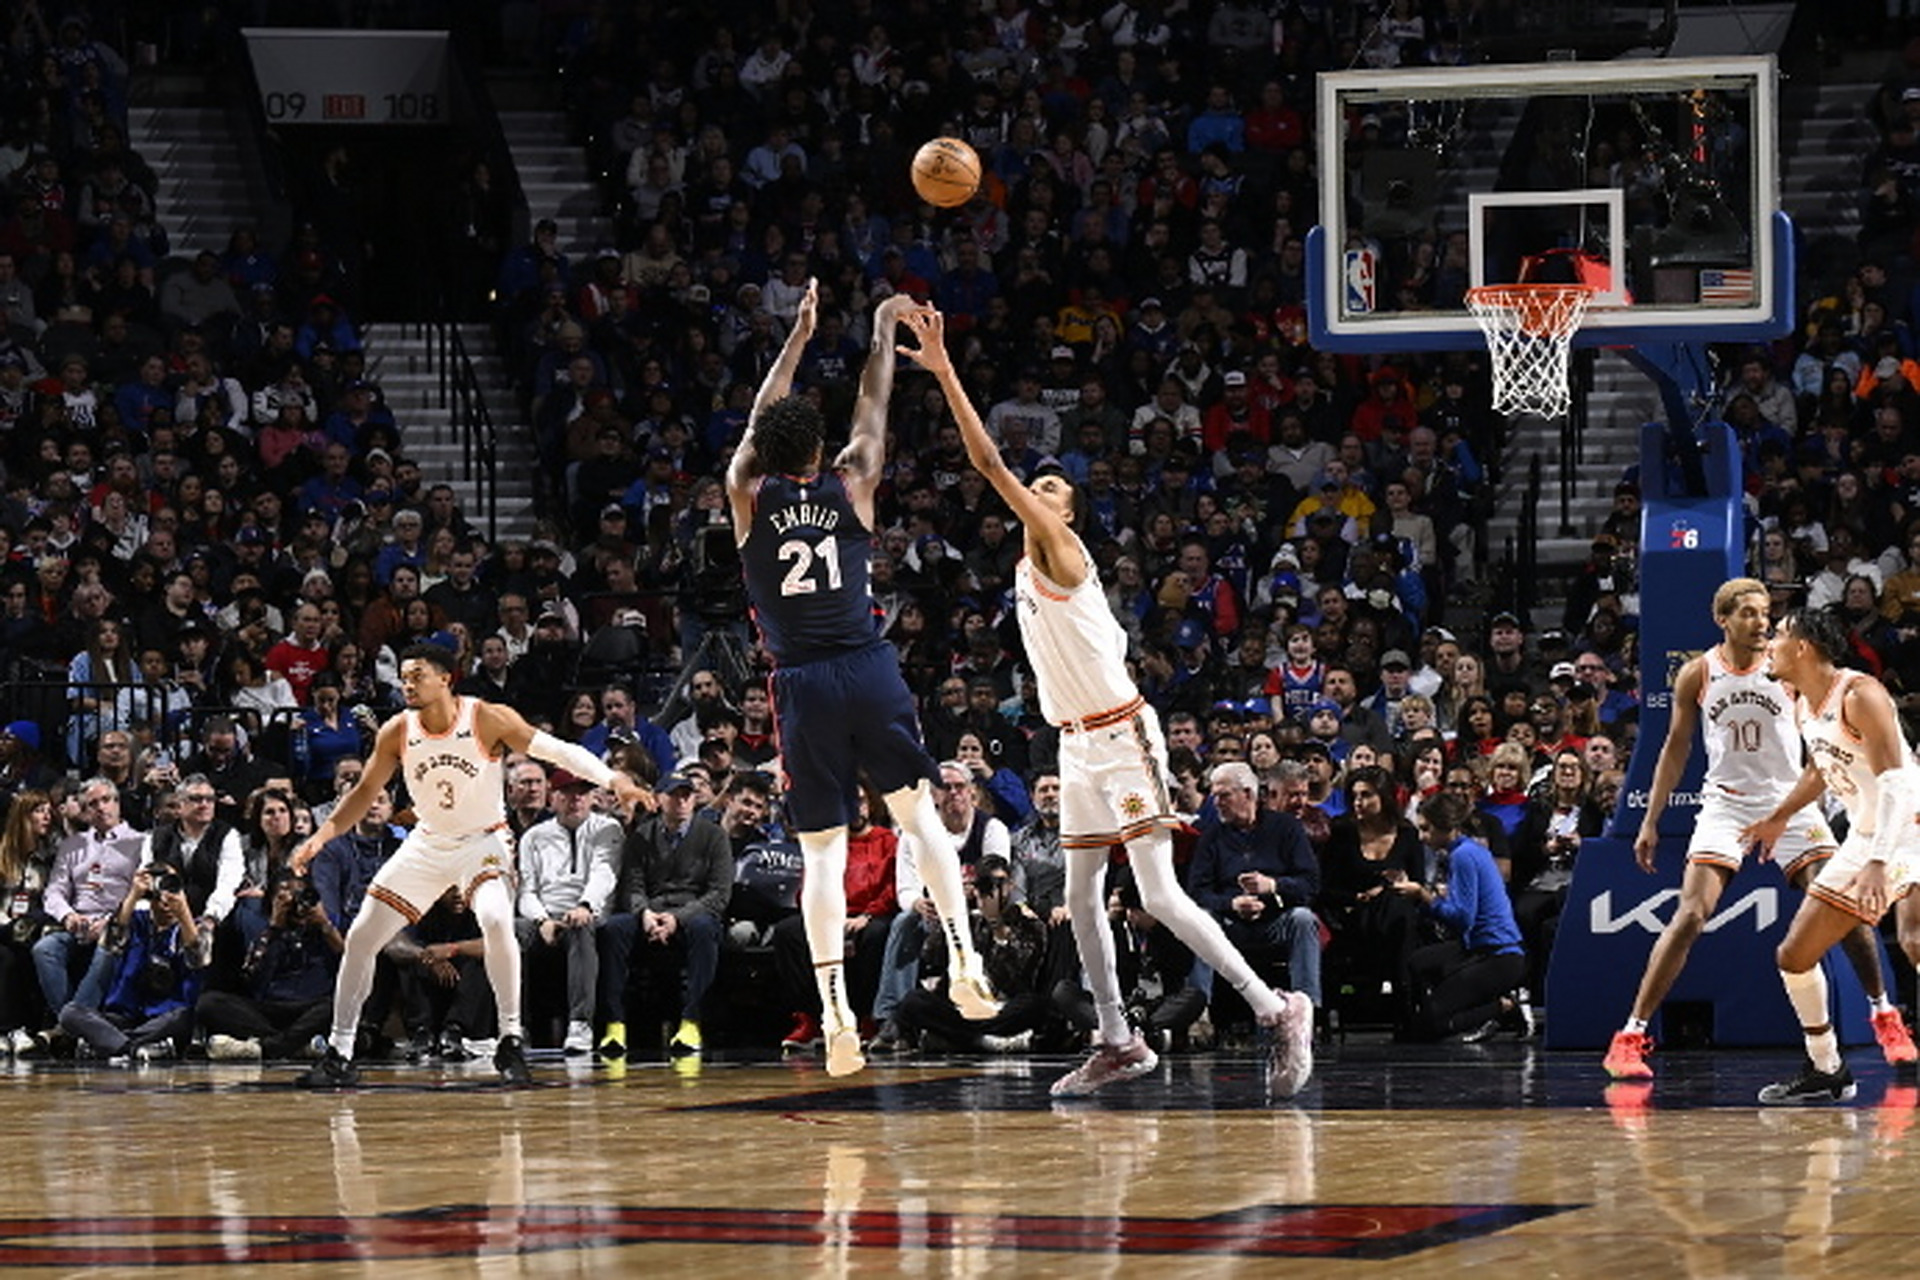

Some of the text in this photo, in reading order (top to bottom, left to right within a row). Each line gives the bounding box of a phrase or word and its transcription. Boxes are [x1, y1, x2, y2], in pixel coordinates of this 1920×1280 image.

[384, 93, 438, 119] 108
[769, 503, 839, 535] EMBIID
[1670, 529, 1699, 549] 76
[778, 535, 842, 596] 21
[1727, 719, 1762, 752] 10
[436, 780, 455, 810] 3
[1591, 887, 1778, 934] KA
